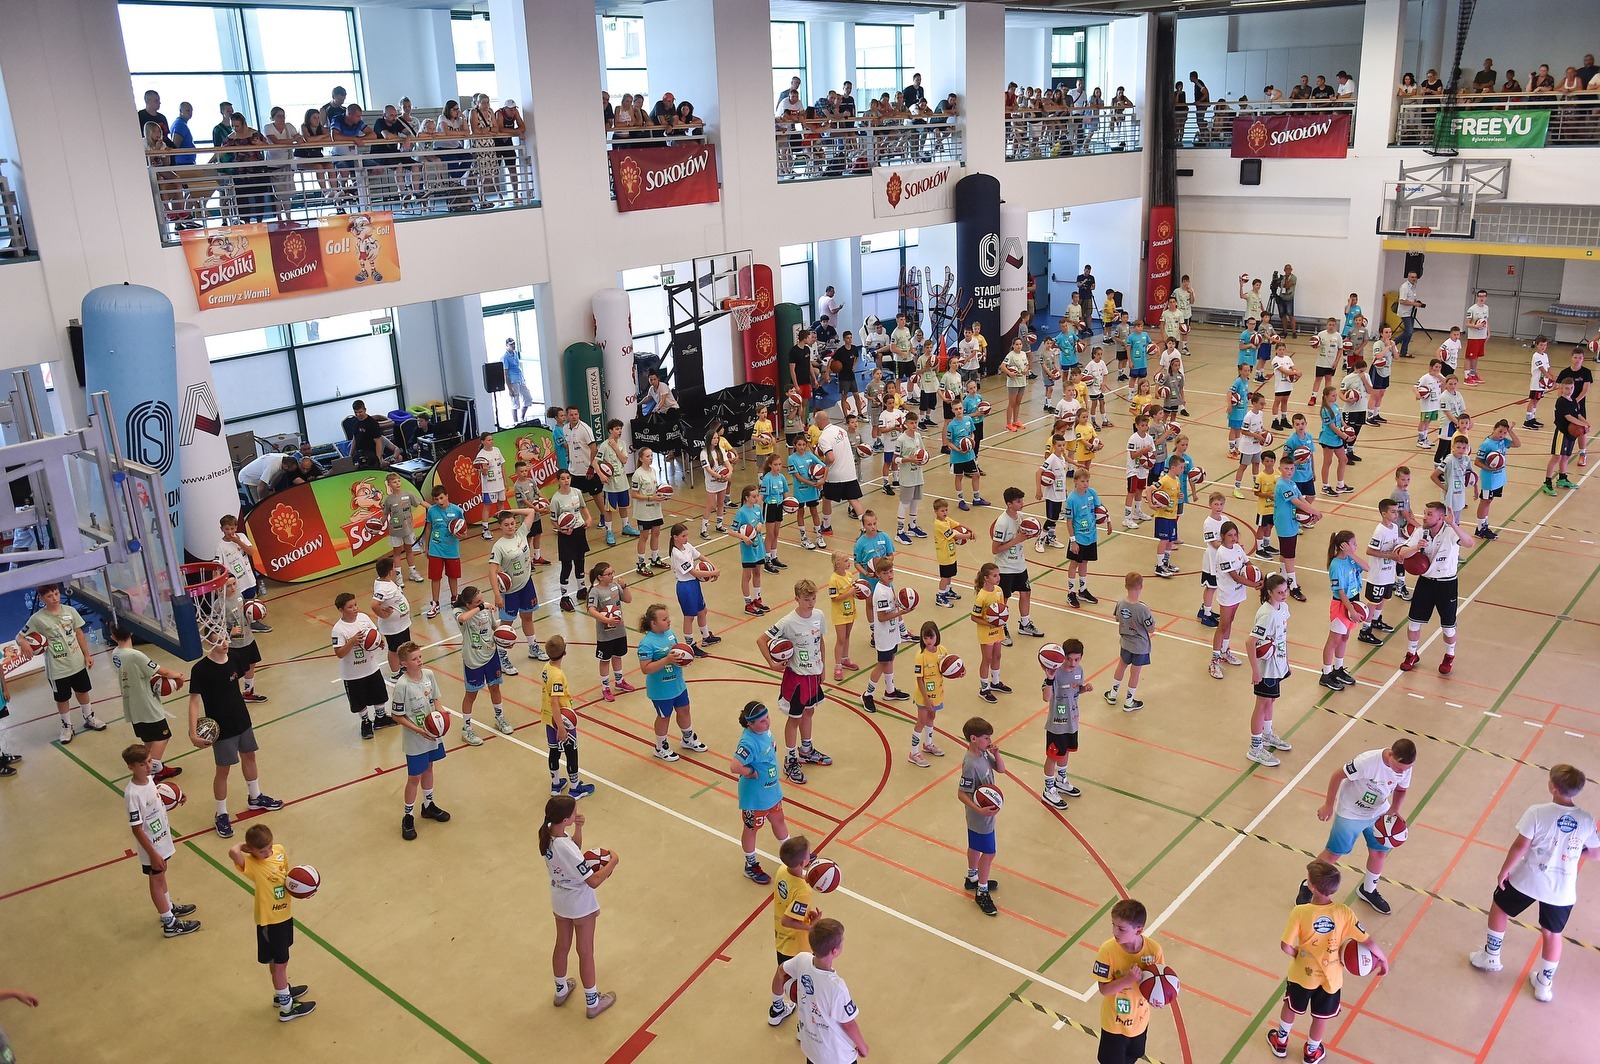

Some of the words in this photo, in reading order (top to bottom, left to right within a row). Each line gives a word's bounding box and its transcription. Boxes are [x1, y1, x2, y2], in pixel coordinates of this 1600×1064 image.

[1270, 118, 1332, 146] SOKOŁÓW
[1450, 114, 1532, 135] FREEYU
[645, 149, 709, 191] SOKOŁÓW
[904, 165, 951, 200] SOKOŁÓW
[376, 225, 390, 236] Gol!
[325, 237, 350, 255] Gol!
[200, 254, 254, 290] Sokoliki
[279, 260, 318, 283] SOKOŁÓW
[208, 294, 237, 304] Gramy
[243, 287, 270, 300] Wami!
[594, 416, 603, 441] KASA
[270, 534, 323, 572] SOKOŁÓW
[1372, 585, 1385, 597] 50
[152, 830, 168, 844] Hertz
[271, 902, 289, 911] Hertz
[1117, 1003, 1130, 1013] YU
